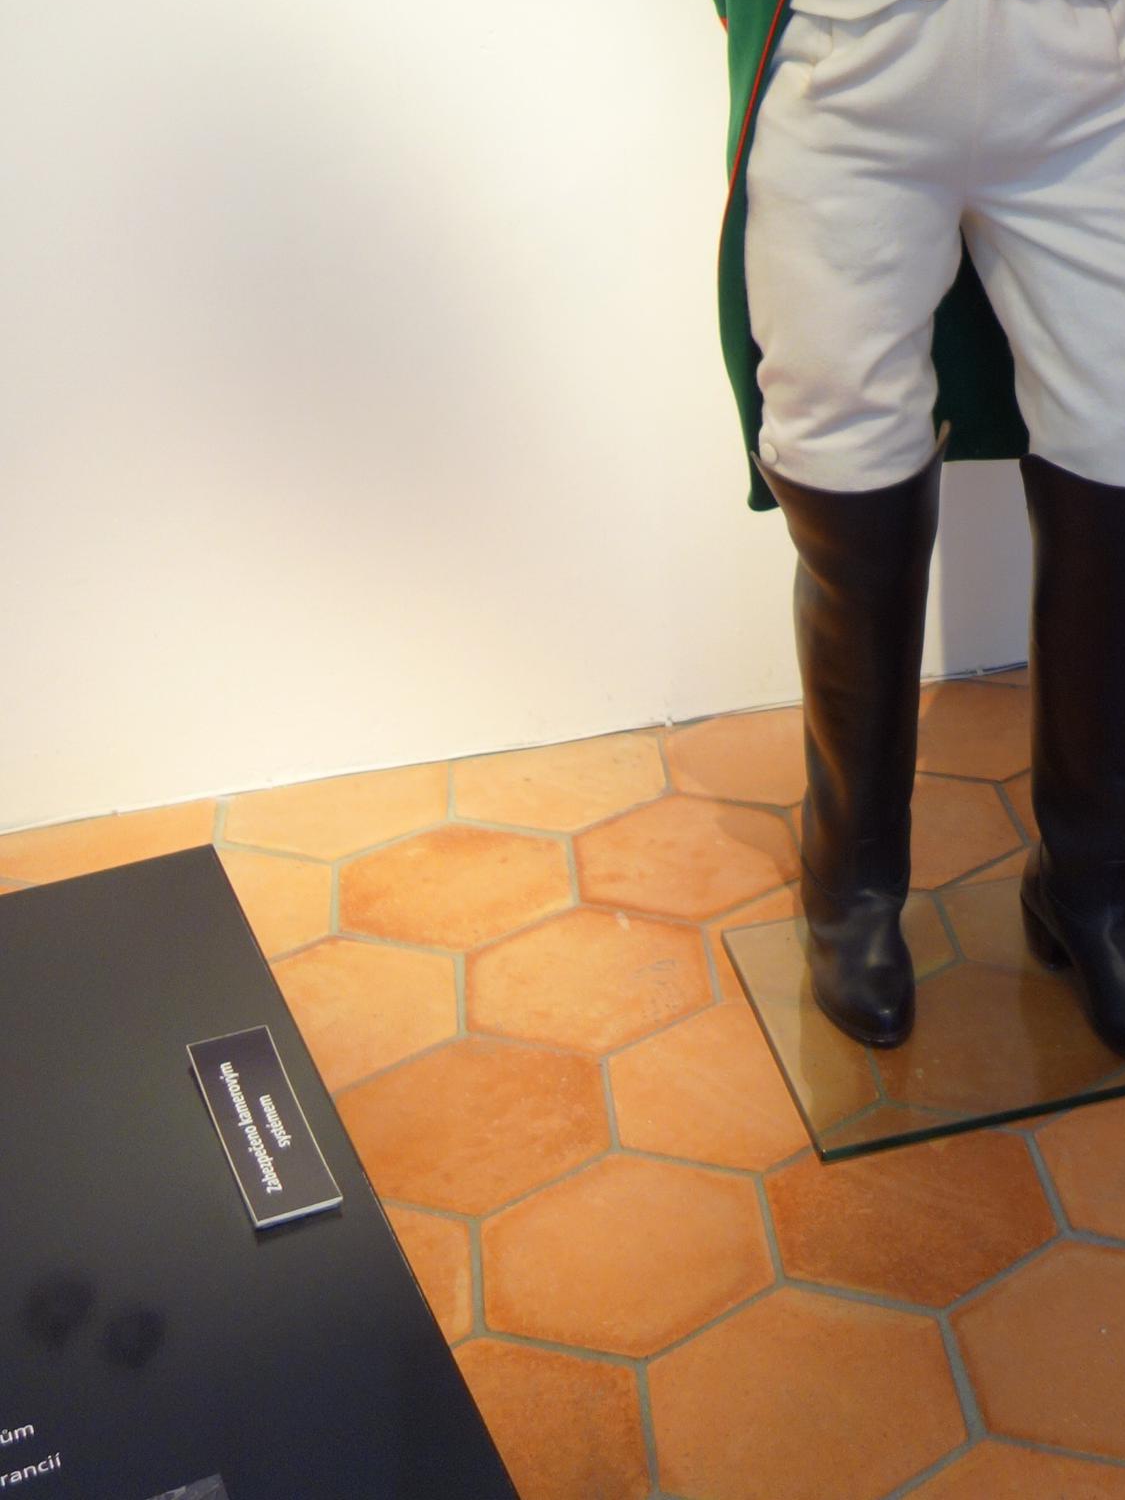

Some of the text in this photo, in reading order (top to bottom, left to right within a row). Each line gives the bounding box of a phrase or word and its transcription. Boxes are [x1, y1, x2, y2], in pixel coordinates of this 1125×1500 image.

[220, 1062, 282, 1194] Zabezpečeno kamerovým
[260, 1094, 292, 1148] systémem
